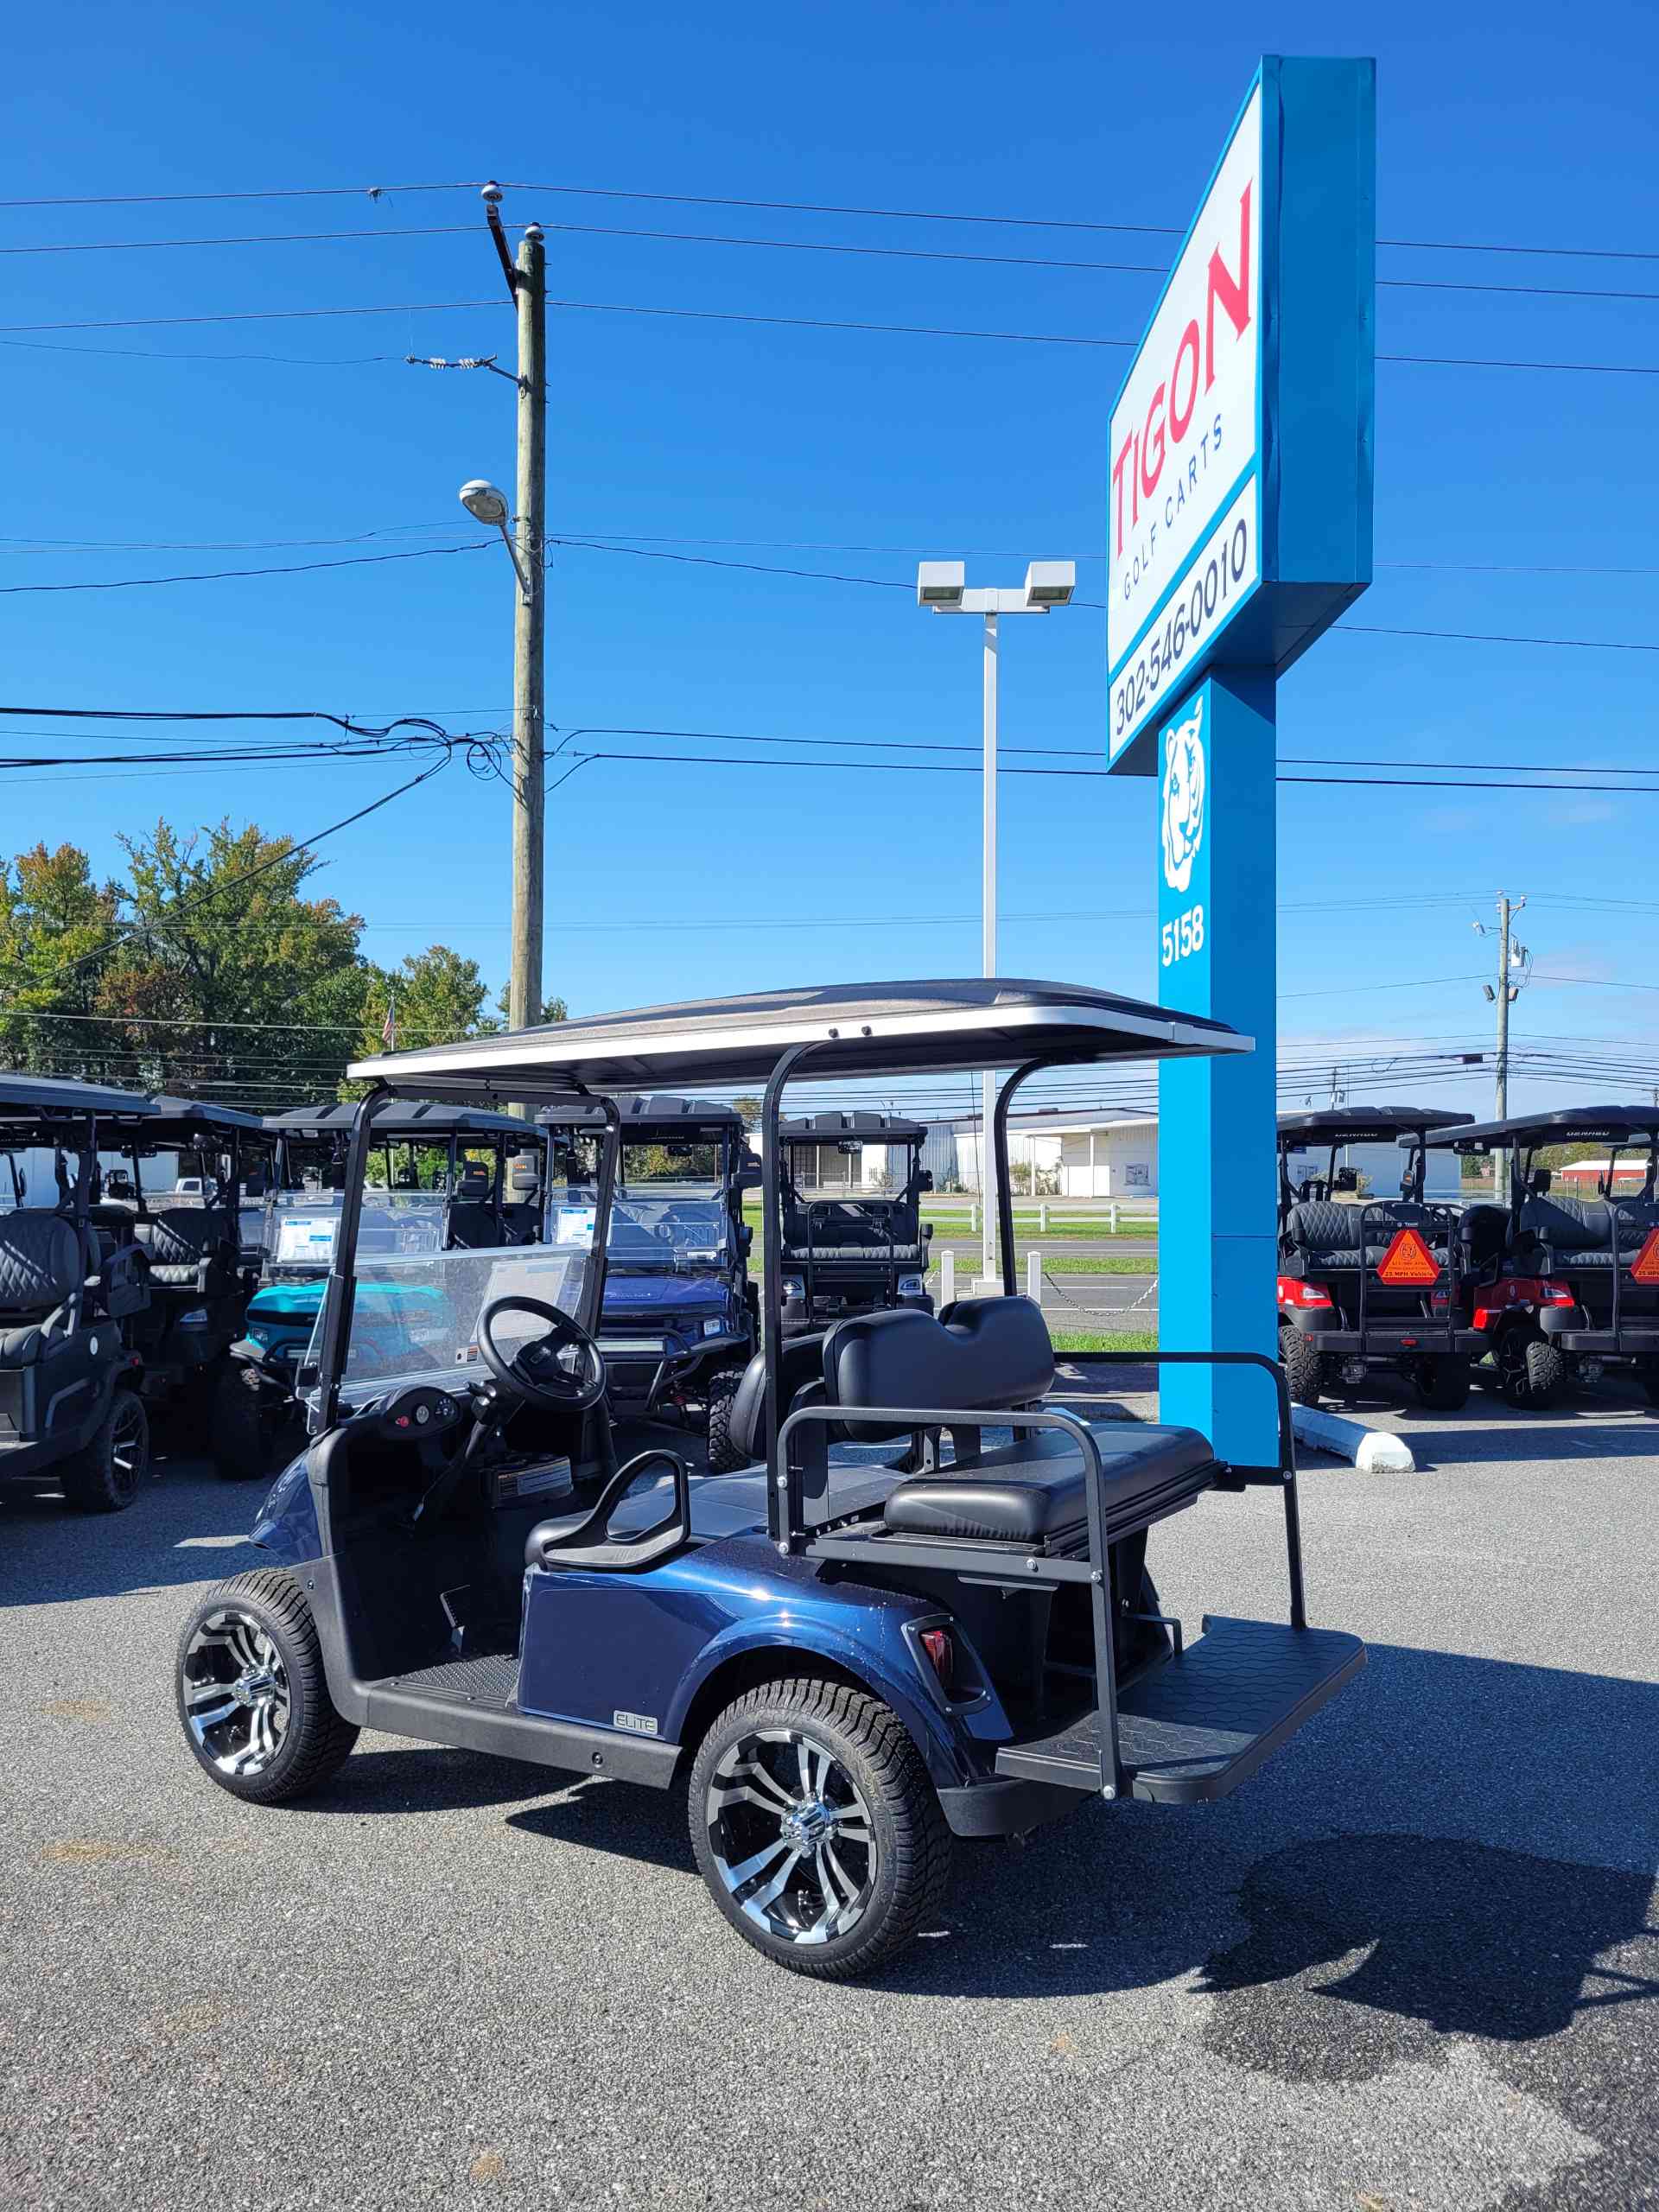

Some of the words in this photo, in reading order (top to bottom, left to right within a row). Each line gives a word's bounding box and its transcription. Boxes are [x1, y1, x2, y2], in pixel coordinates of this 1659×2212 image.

[1112, 175, 1253, 561] TIGON
[1124, 521, 1157, 601] GOLF
[1165, 413, 1223, 529] CARTS
[1116, 518, 1248, 736] 302-546-0010
[1161, 904, 1205, 967] 5158
